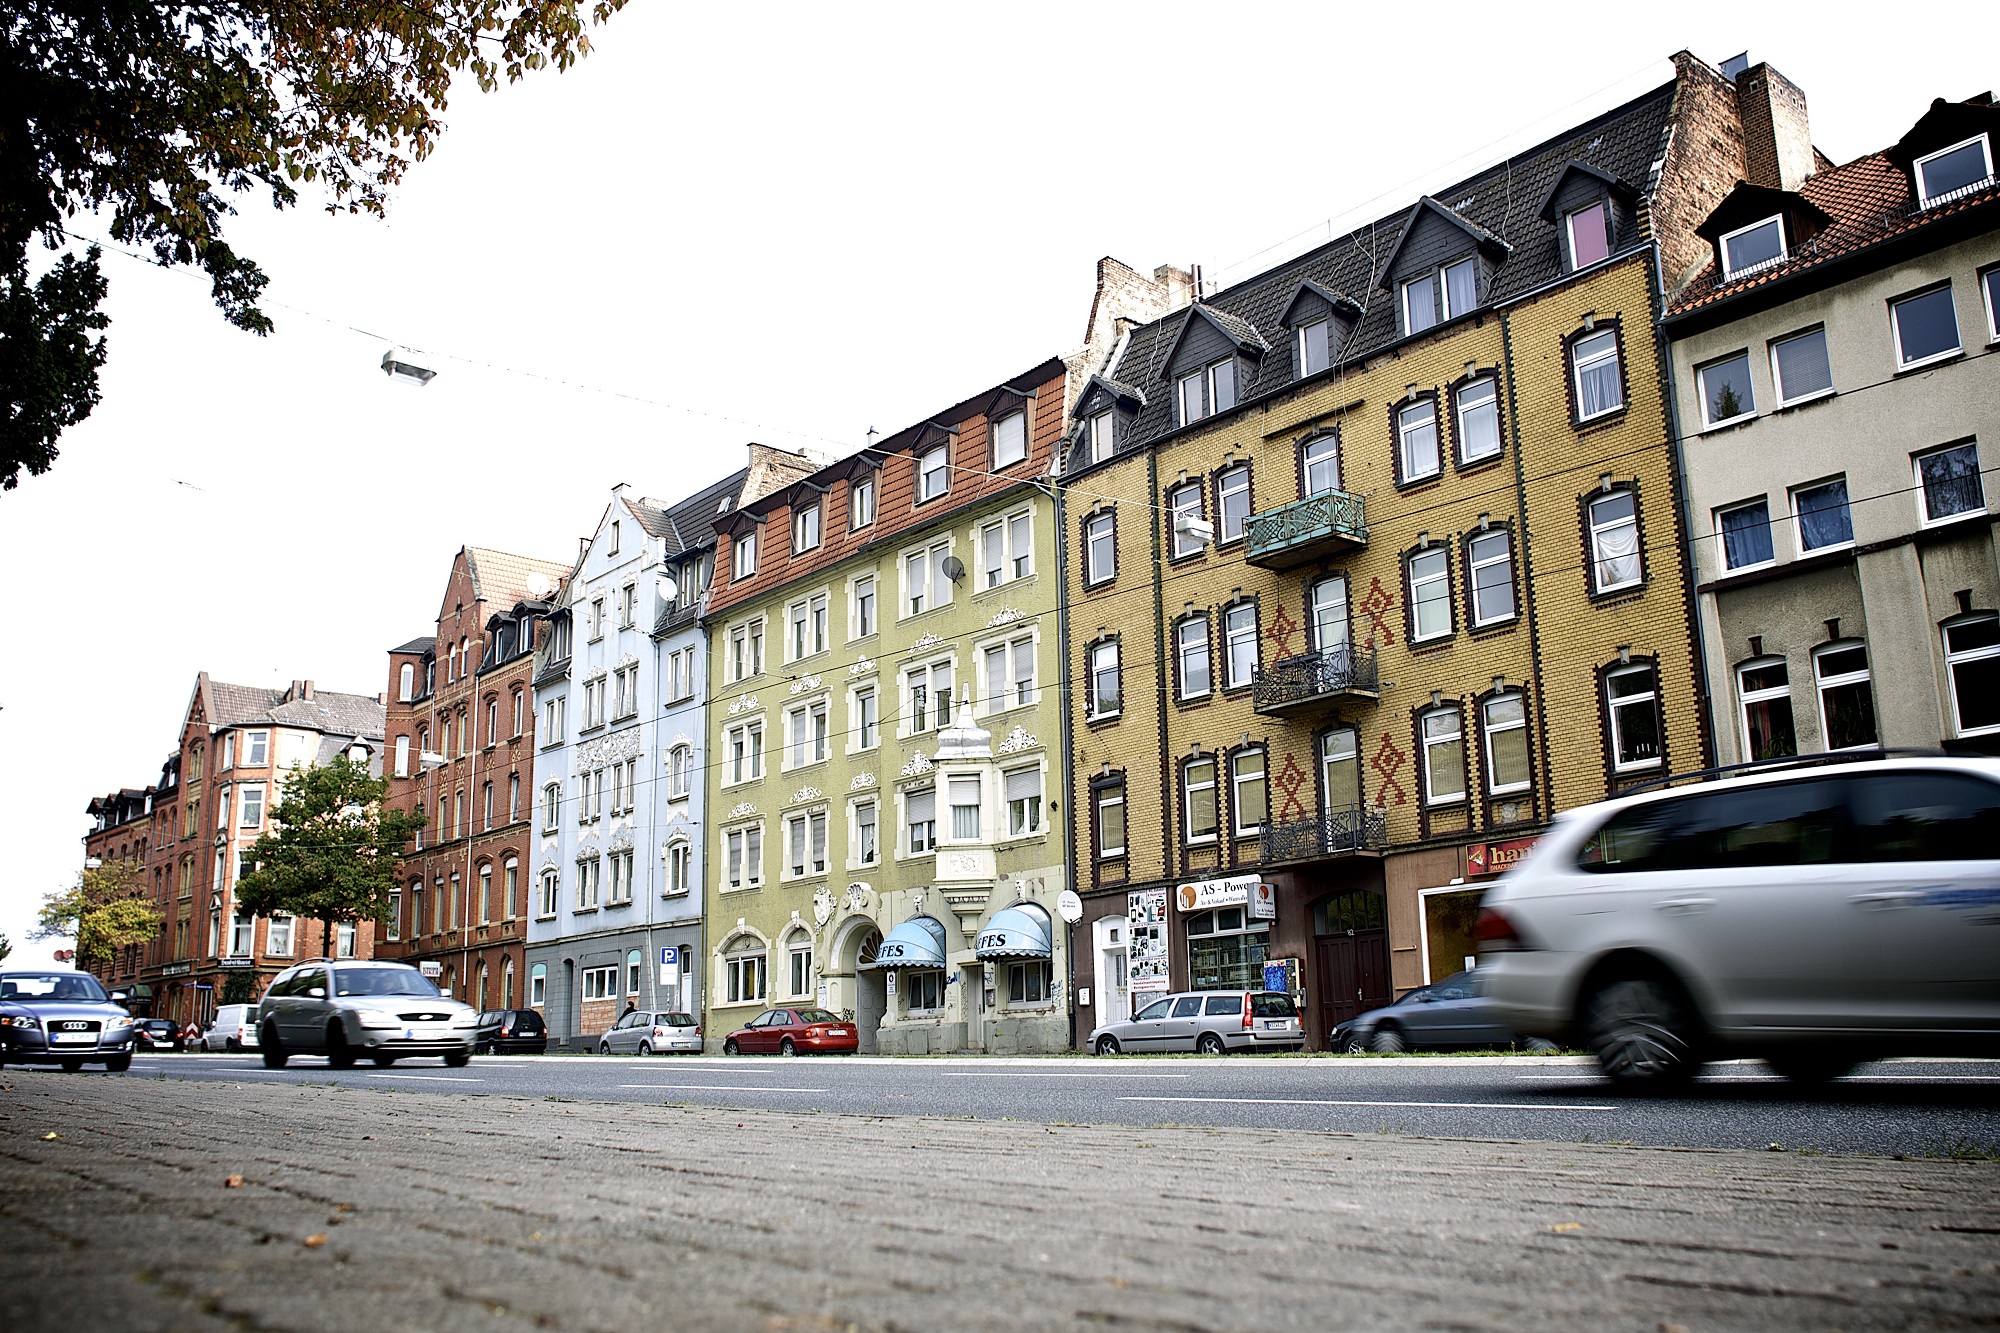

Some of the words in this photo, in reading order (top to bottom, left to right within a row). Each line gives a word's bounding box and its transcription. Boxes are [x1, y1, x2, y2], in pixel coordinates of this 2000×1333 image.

[1490, 841, 1537, 864] han'
[1200, 883, 1215, 896] AS
[1224, 881, 1248, 893] Powe
[664, 949, 675, 964] P
